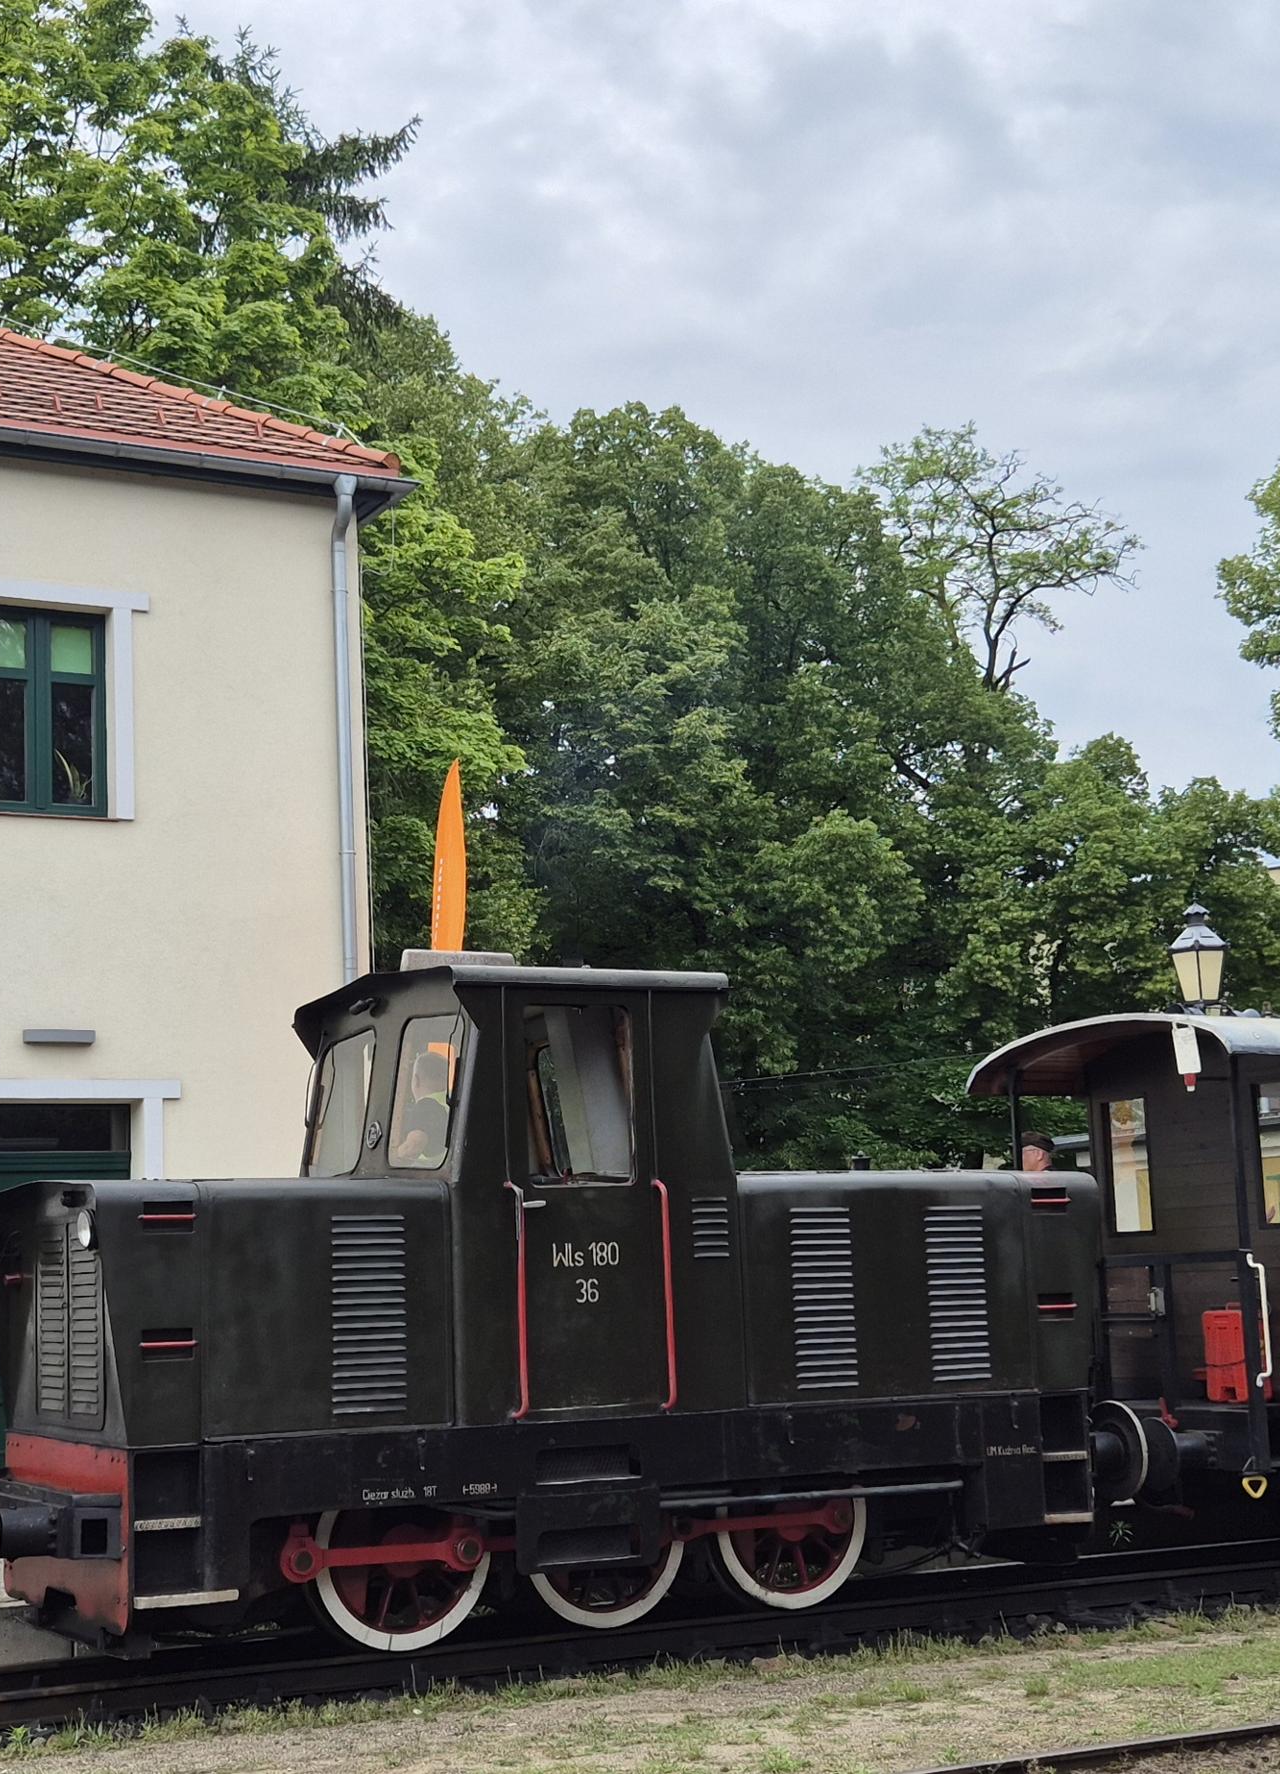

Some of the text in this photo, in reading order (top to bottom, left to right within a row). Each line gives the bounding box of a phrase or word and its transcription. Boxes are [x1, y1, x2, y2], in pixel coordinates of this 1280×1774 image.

[552, 1241, 619, 1267] Wls 180
[575, 1278, 599, 1303] 36
